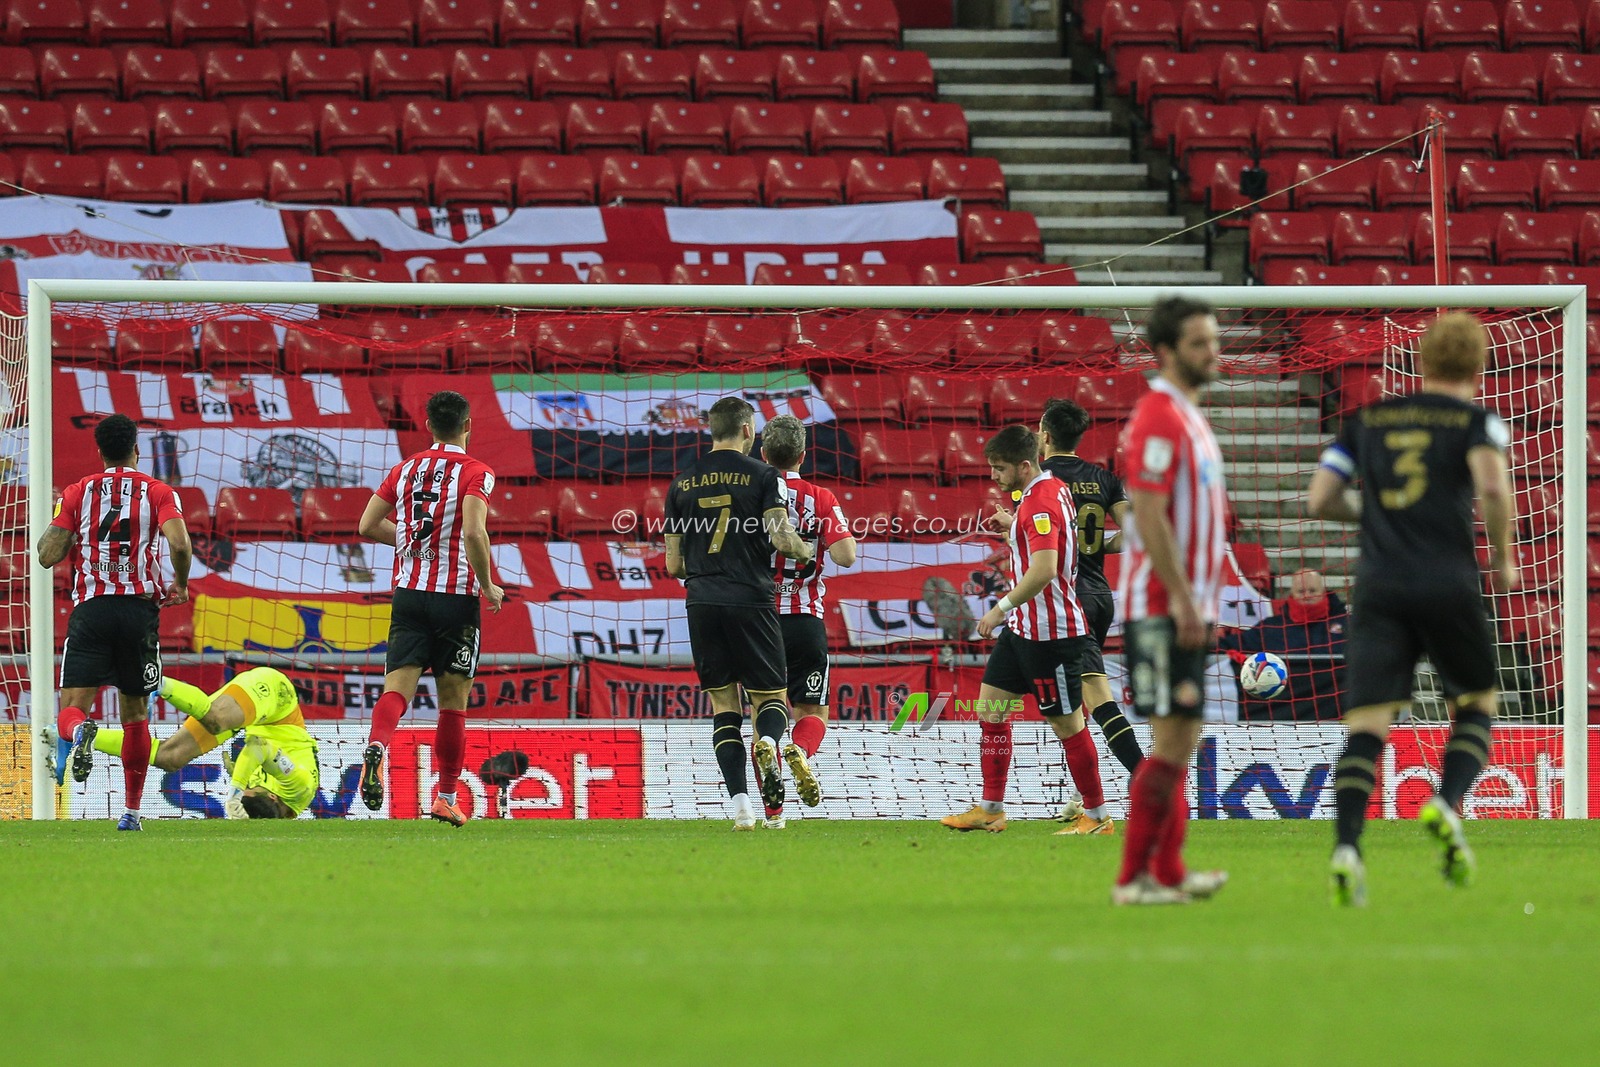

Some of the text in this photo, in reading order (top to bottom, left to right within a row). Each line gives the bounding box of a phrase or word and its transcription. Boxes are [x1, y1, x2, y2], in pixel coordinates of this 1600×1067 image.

[179, 396, 279, 419] Branch
[682, 471, 751, 492] GLADWIN
[1382, 430, 1431, 510] 3
[97, 504, 131, 556] 4
[411, 491, 440, 541] 5
[698, 494, 732, 554] 7
[494, 674, 561, 707] AFC
[837, 683, 909, 722] CATS
